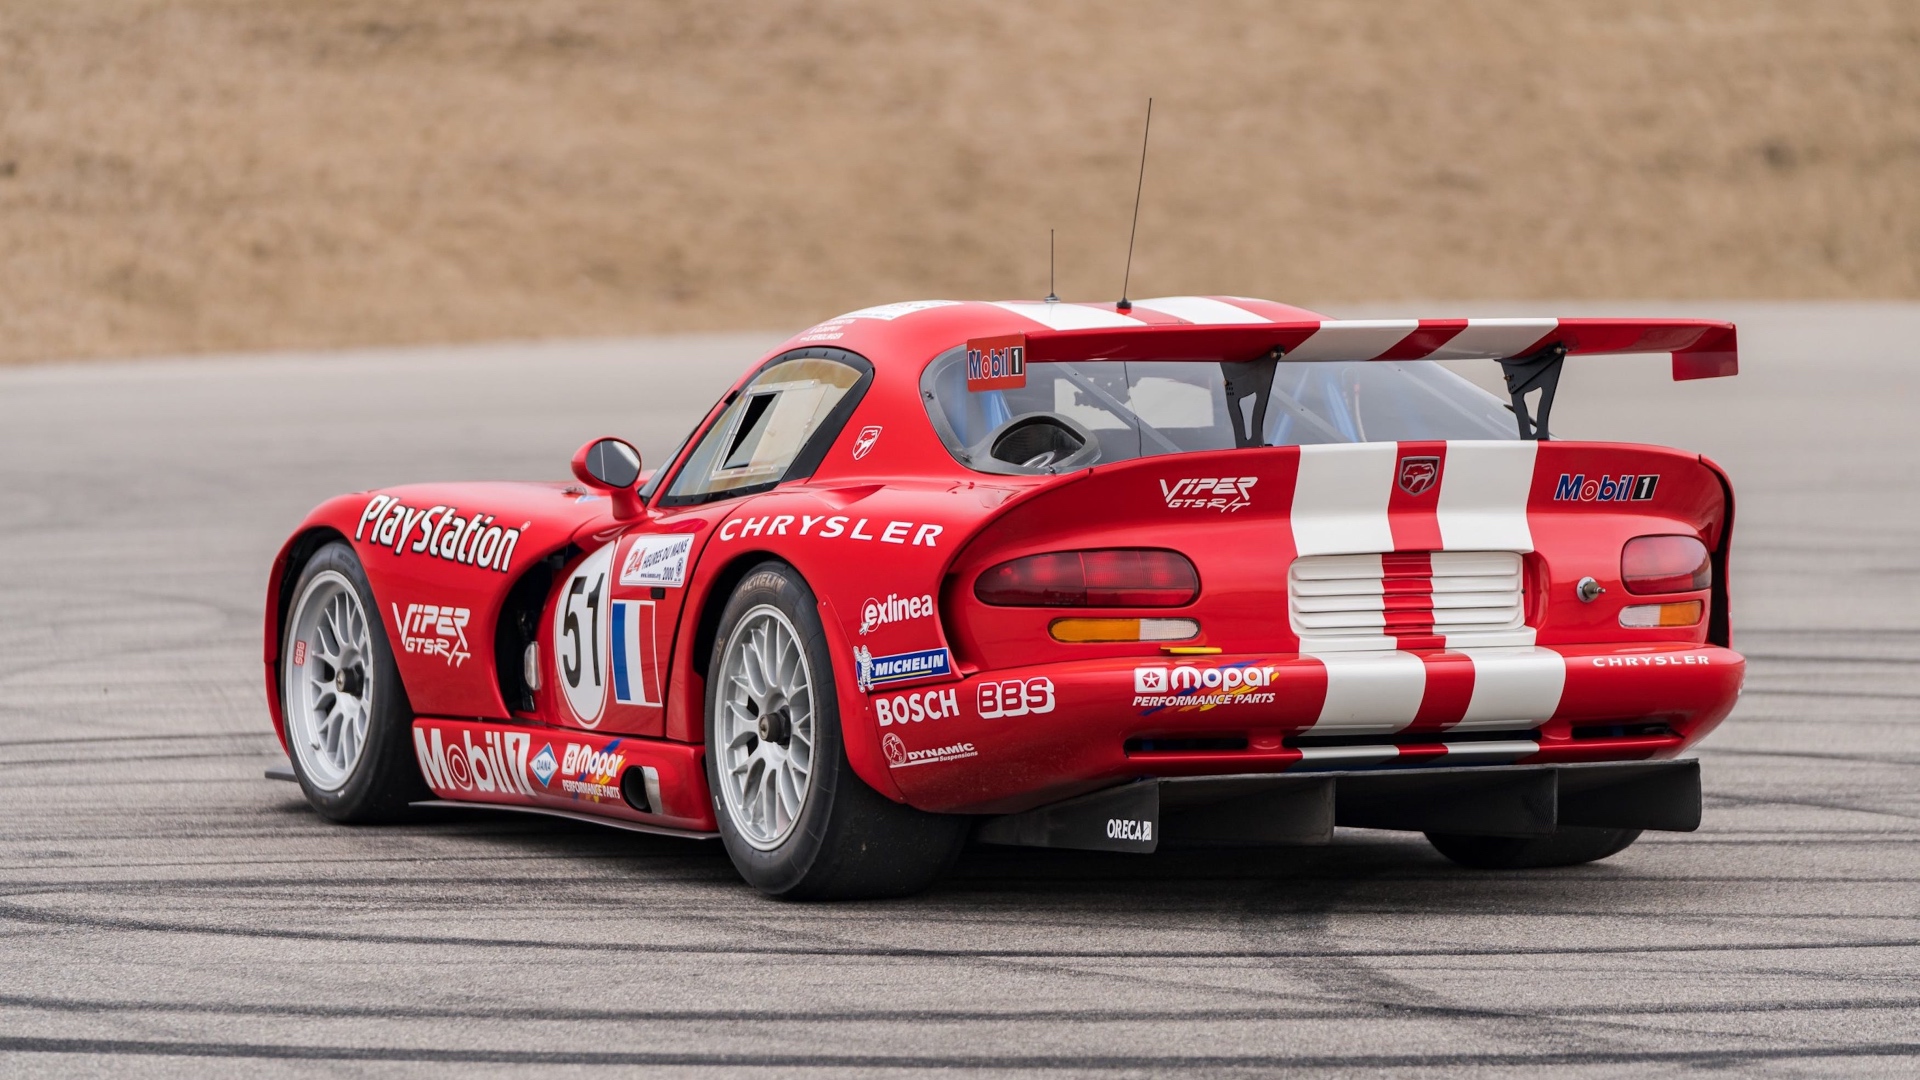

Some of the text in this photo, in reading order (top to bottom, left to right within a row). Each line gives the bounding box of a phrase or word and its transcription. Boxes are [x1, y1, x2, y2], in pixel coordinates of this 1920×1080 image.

[968, 347, 1009, 380] Mobil
[1159, 477, 1258, 503] VIPER
[1553, 474, 1634, 502] Mobil
[354, 494, 521, 573] PlayStation
[719, 515, 944, 547] CHRYSLER
[624, 547, 647, 577] 24
[642, 549, 664, 570] HEURES
[662, 545, 673, 562] DU
[670, 538, 690, 559] MANS
[662, 566, 675, 581] 2000
[863, 593, 934, 627] exlinea
[391, 602, 471, 652] VIPER
[562, 572, 605, 689] 51
[875, 654, 944, 677] MICHELIN
[1592, 655, 1710, 667] CHRYSLER
[1170, 666, 1275, 692] Mopar
[875, 688, 960, 727] BOSCH
[976, 676, 1055, 720] BBS
[1132, 693, 1276, 707] PERFORMANCE PARTS
[413, 727, 516, 794] Mobil
[536, 759, 551, 772] DANA
[939, 751, 978, 762] Suspensions
[562, 779, 620, 799] PERFORMANCE PARTS
[1106, 818, 1142, 840] ORECA
